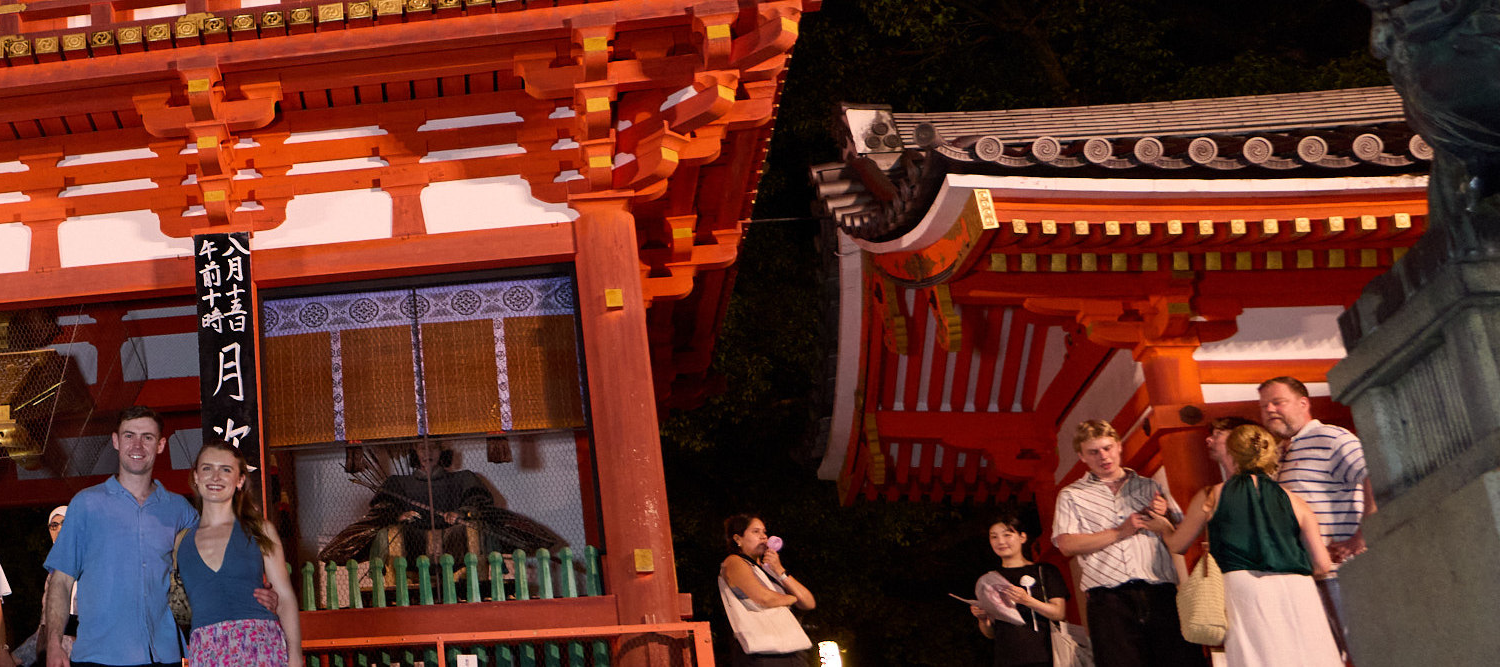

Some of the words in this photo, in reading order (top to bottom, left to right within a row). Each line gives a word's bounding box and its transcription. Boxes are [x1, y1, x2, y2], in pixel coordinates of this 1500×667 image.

[199, 240, 224, 333] 午前十時
[222, 235, 250, 332] 八月十五日
